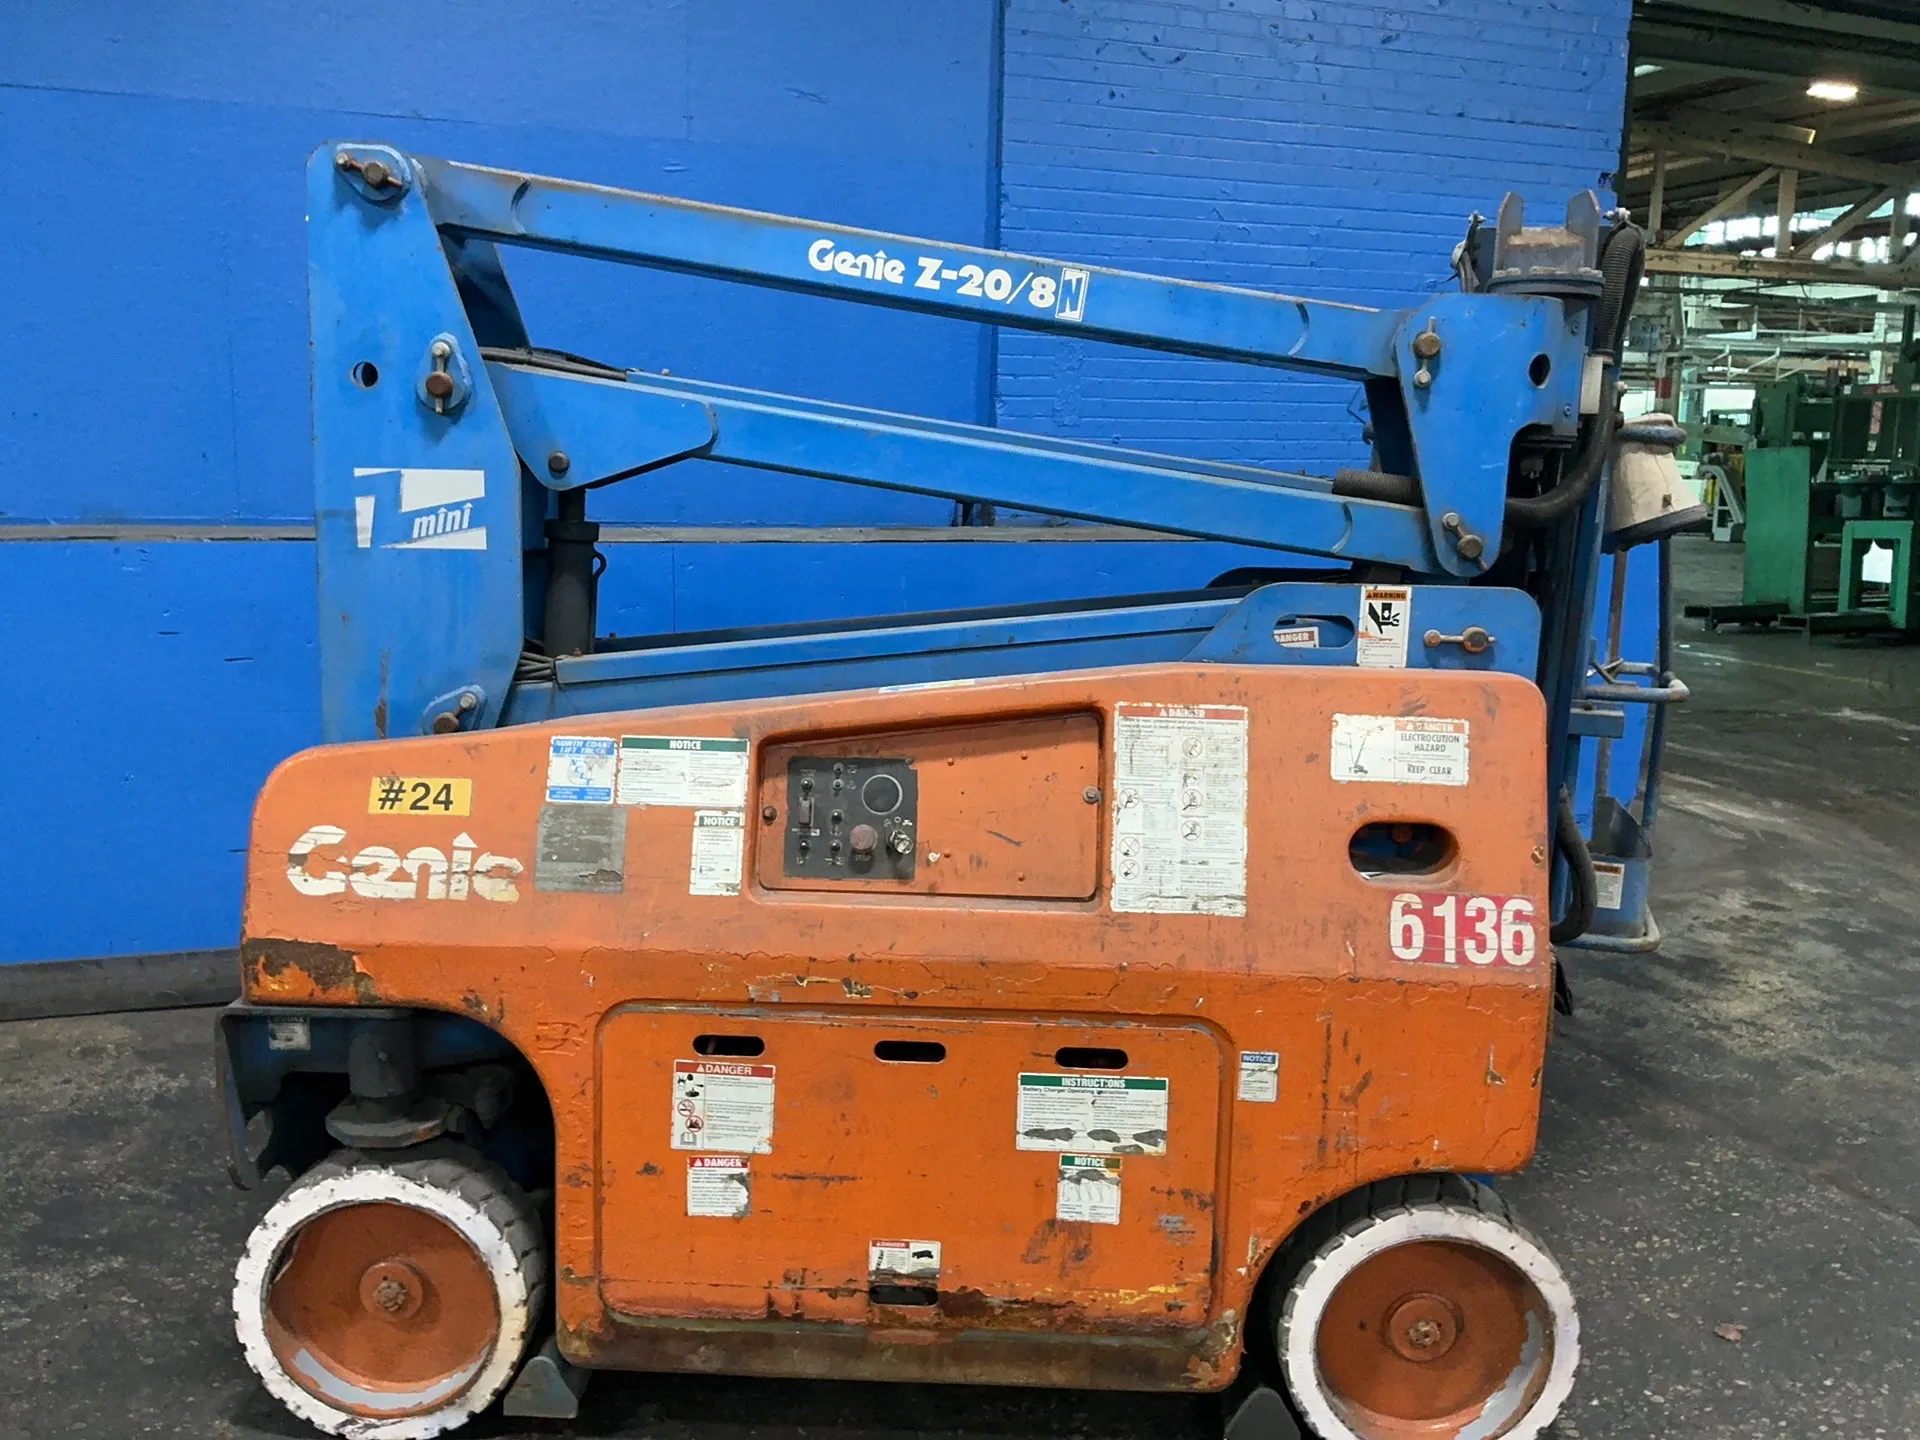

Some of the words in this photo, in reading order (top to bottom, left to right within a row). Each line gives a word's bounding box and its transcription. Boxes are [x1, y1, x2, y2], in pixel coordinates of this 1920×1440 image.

[808, 239, 905, 285] Genie
[412, 502, 473, 539] mini
[1273, 632, 1310, 643] DANGER
[1168, 708, 1205, 718] DANGER
[1416, 722, 1454, 732] DANGER
[1401, 733, 1460, 743] ELECTROCUTION
[554, 740, 583, 748] NORTH
[669, 739, 701, 750] NOTICE
[1414, 743, 1446, 752] HAZARD
[1407, 763, 1425, 774] KEEP
[1429, 766, 1452, 775] CLEAR
[378, 780, 454, 811] #24
[704, 816, 736, 826] NOTICE
[1389, 893, 1536, 966] 6136
[1243, 1054, 1273, 1063] NOTICE
[705, 1064, 752, 1076] DANGER
[1061, 1077, 1126, 1089] INSTRUCTIONS
[703, 1158, 742, 1167] DANGER
[1074, 1156, 1106, 1167] NOTICE
